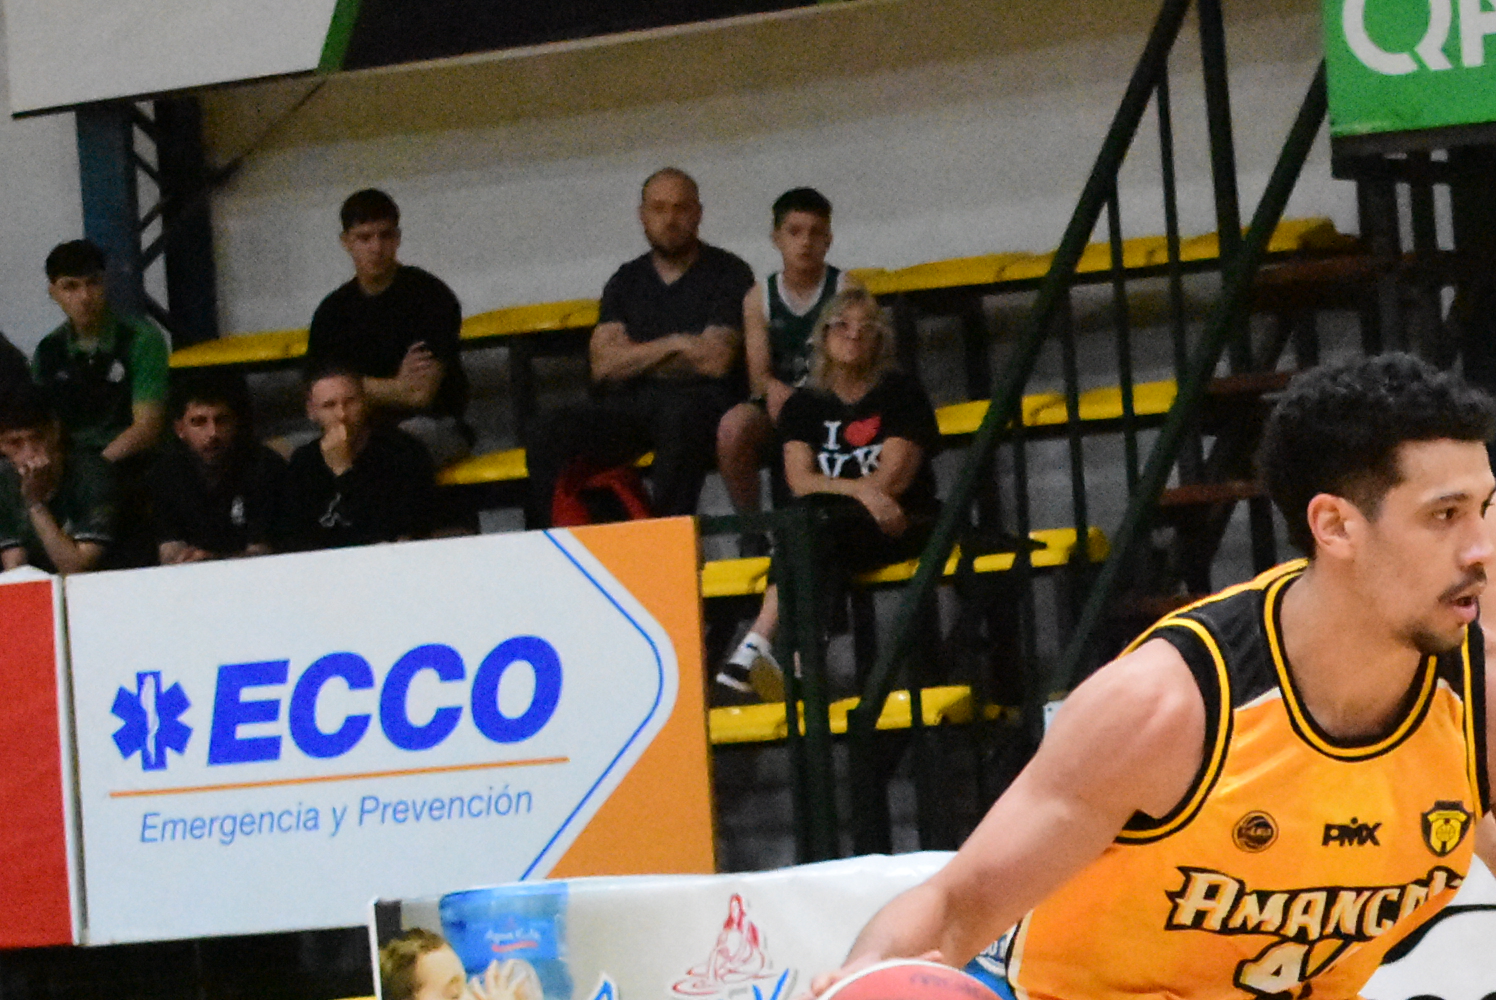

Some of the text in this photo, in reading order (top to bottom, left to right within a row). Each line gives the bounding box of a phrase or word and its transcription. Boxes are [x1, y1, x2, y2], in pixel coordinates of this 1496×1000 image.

[207, 635, 563, 766] ECCO
[139, 785, 533, 846] Emergencia y Prevención
